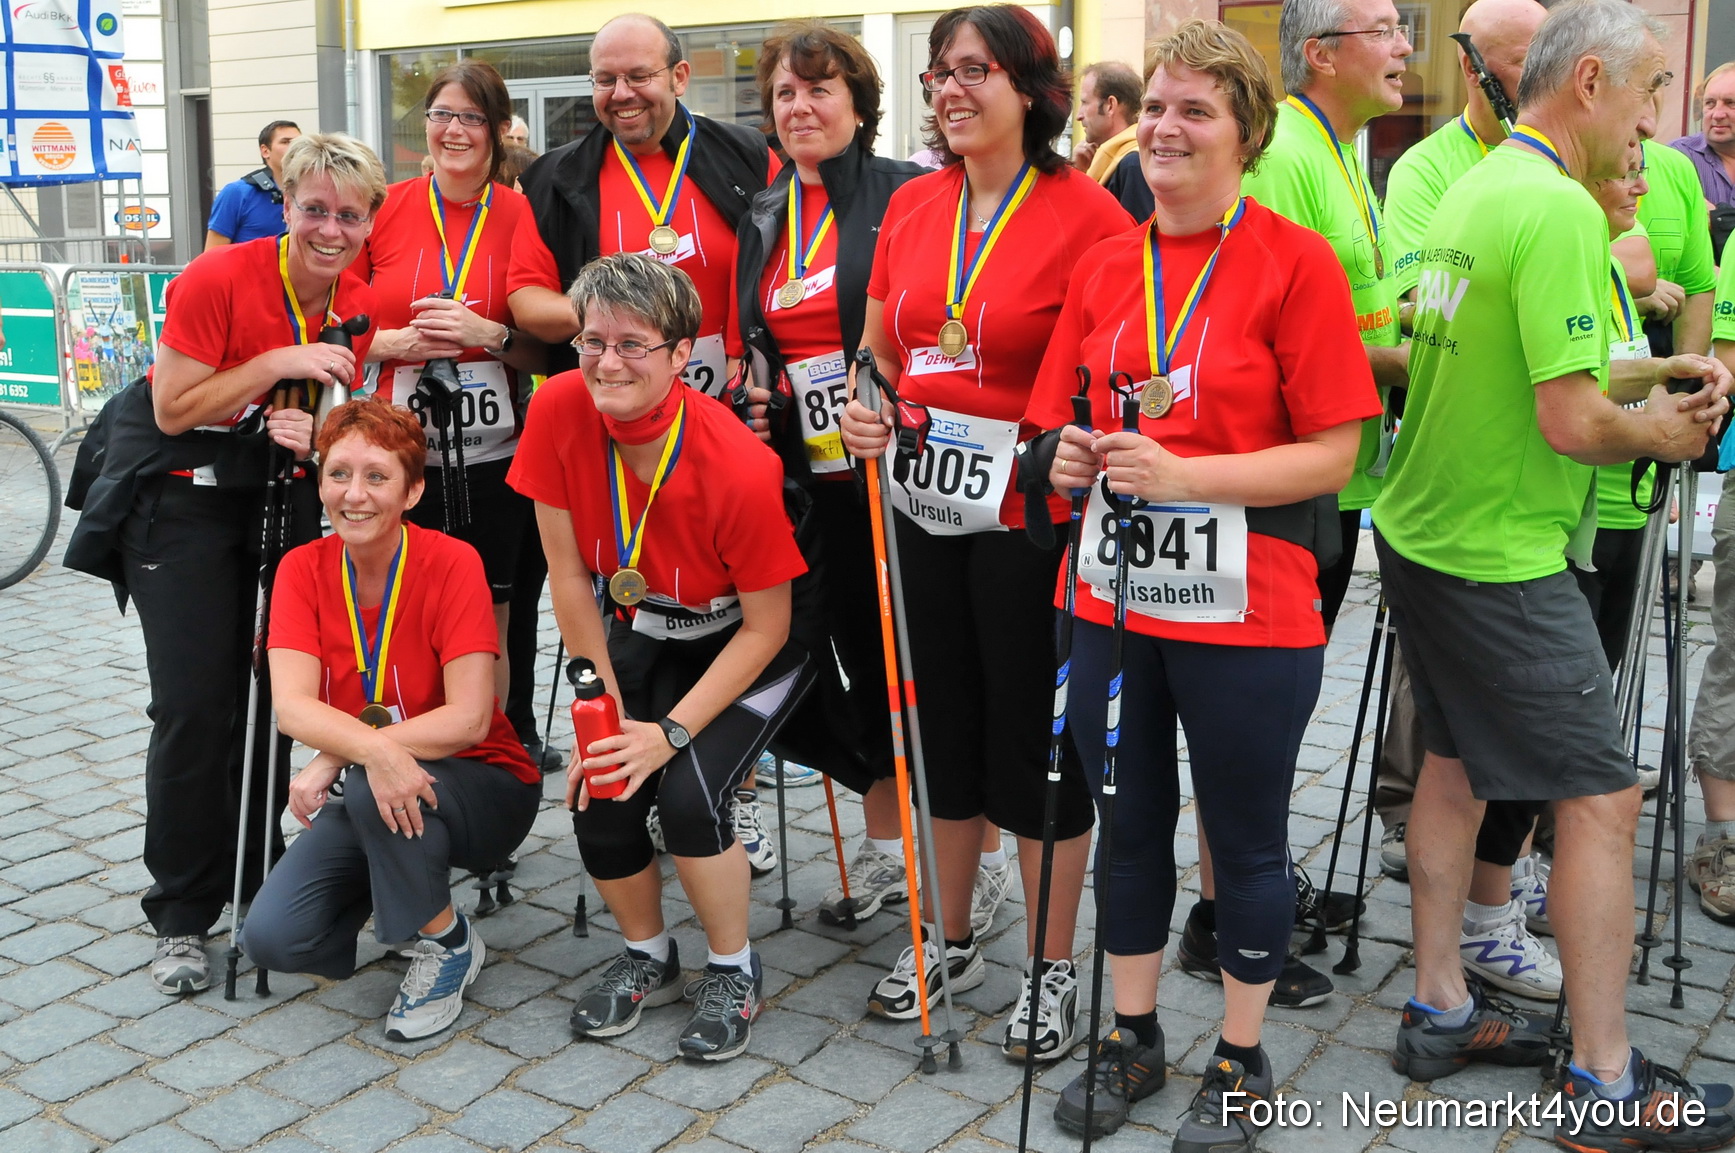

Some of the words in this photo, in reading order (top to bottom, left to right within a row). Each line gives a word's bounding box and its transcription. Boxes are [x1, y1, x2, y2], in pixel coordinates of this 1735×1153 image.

[118, 214, 158, 222] OSIL
[1566, 313, 1595, 336] Fe
[9, 384, 29, 398] 6352
[931, 418, 969, 438] OCK
[427, 435, 482, 451] Adea
[913, 443, 994, 500] 005
[909, 497, 963, 526] Ursula
[1084, 556, 1091, 565] N
[1109, 578, 1215, 605] isabeth
